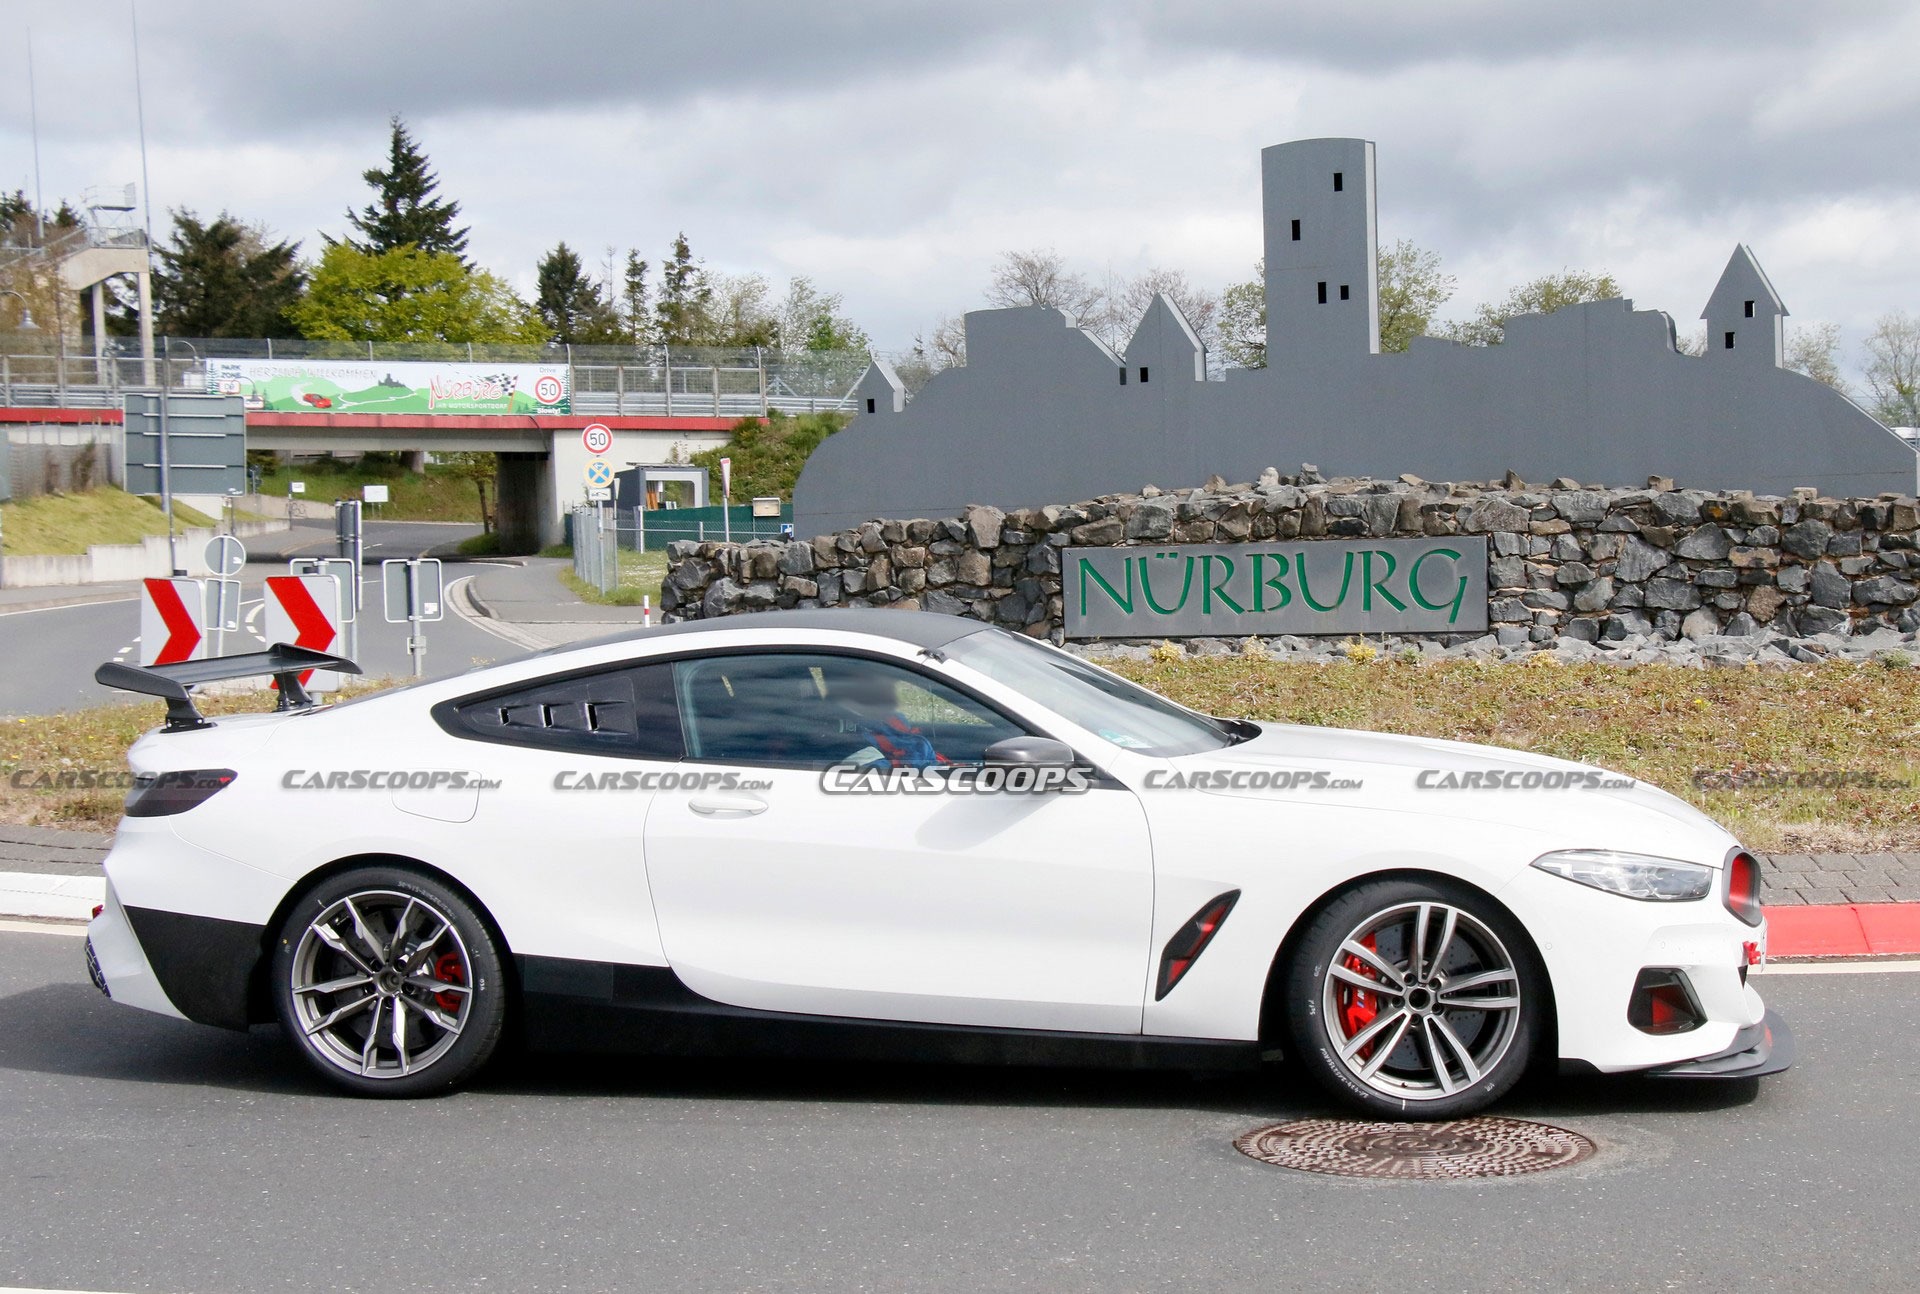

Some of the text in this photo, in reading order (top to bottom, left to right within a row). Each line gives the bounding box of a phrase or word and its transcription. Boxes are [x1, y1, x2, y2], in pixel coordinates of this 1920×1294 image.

[541, 383, 557, 396] 50
[589, 432, 606, 446] 50
[1078, 548, 1468, 624] NÜRBURG
